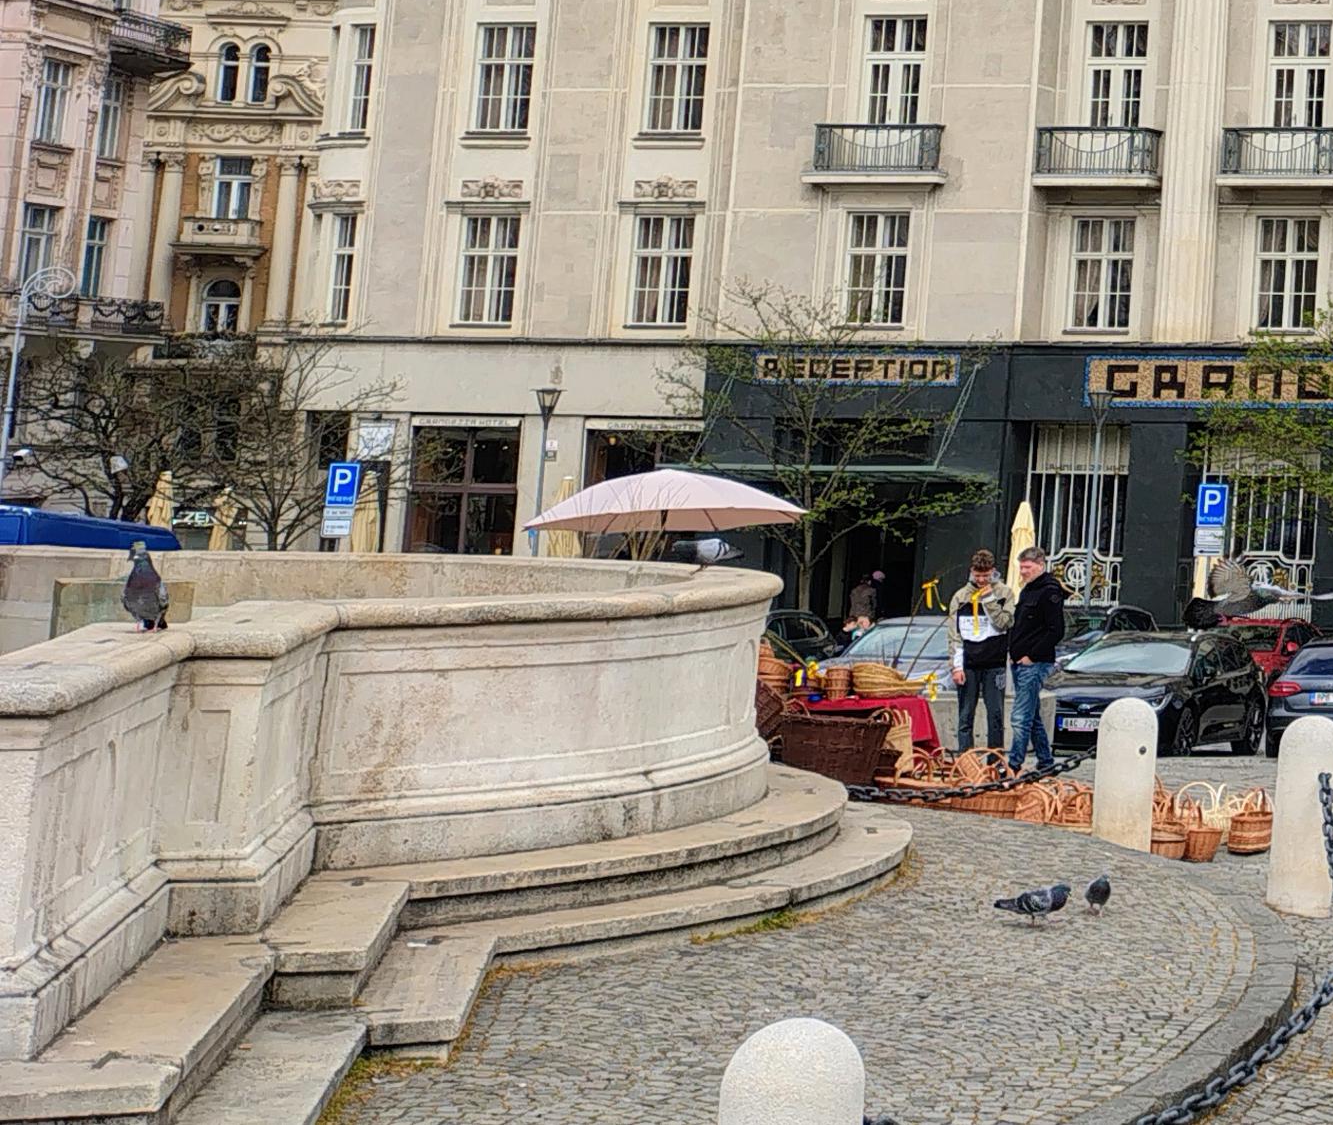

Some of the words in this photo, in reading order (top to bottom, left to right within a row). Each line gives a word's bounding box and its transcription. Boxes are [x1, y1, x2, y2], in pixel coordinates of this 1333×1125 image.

[763, 358, 951, 380] RECEPTION
[333, 468, 352, 493] P
[1204, 489, 1221, 514] P
